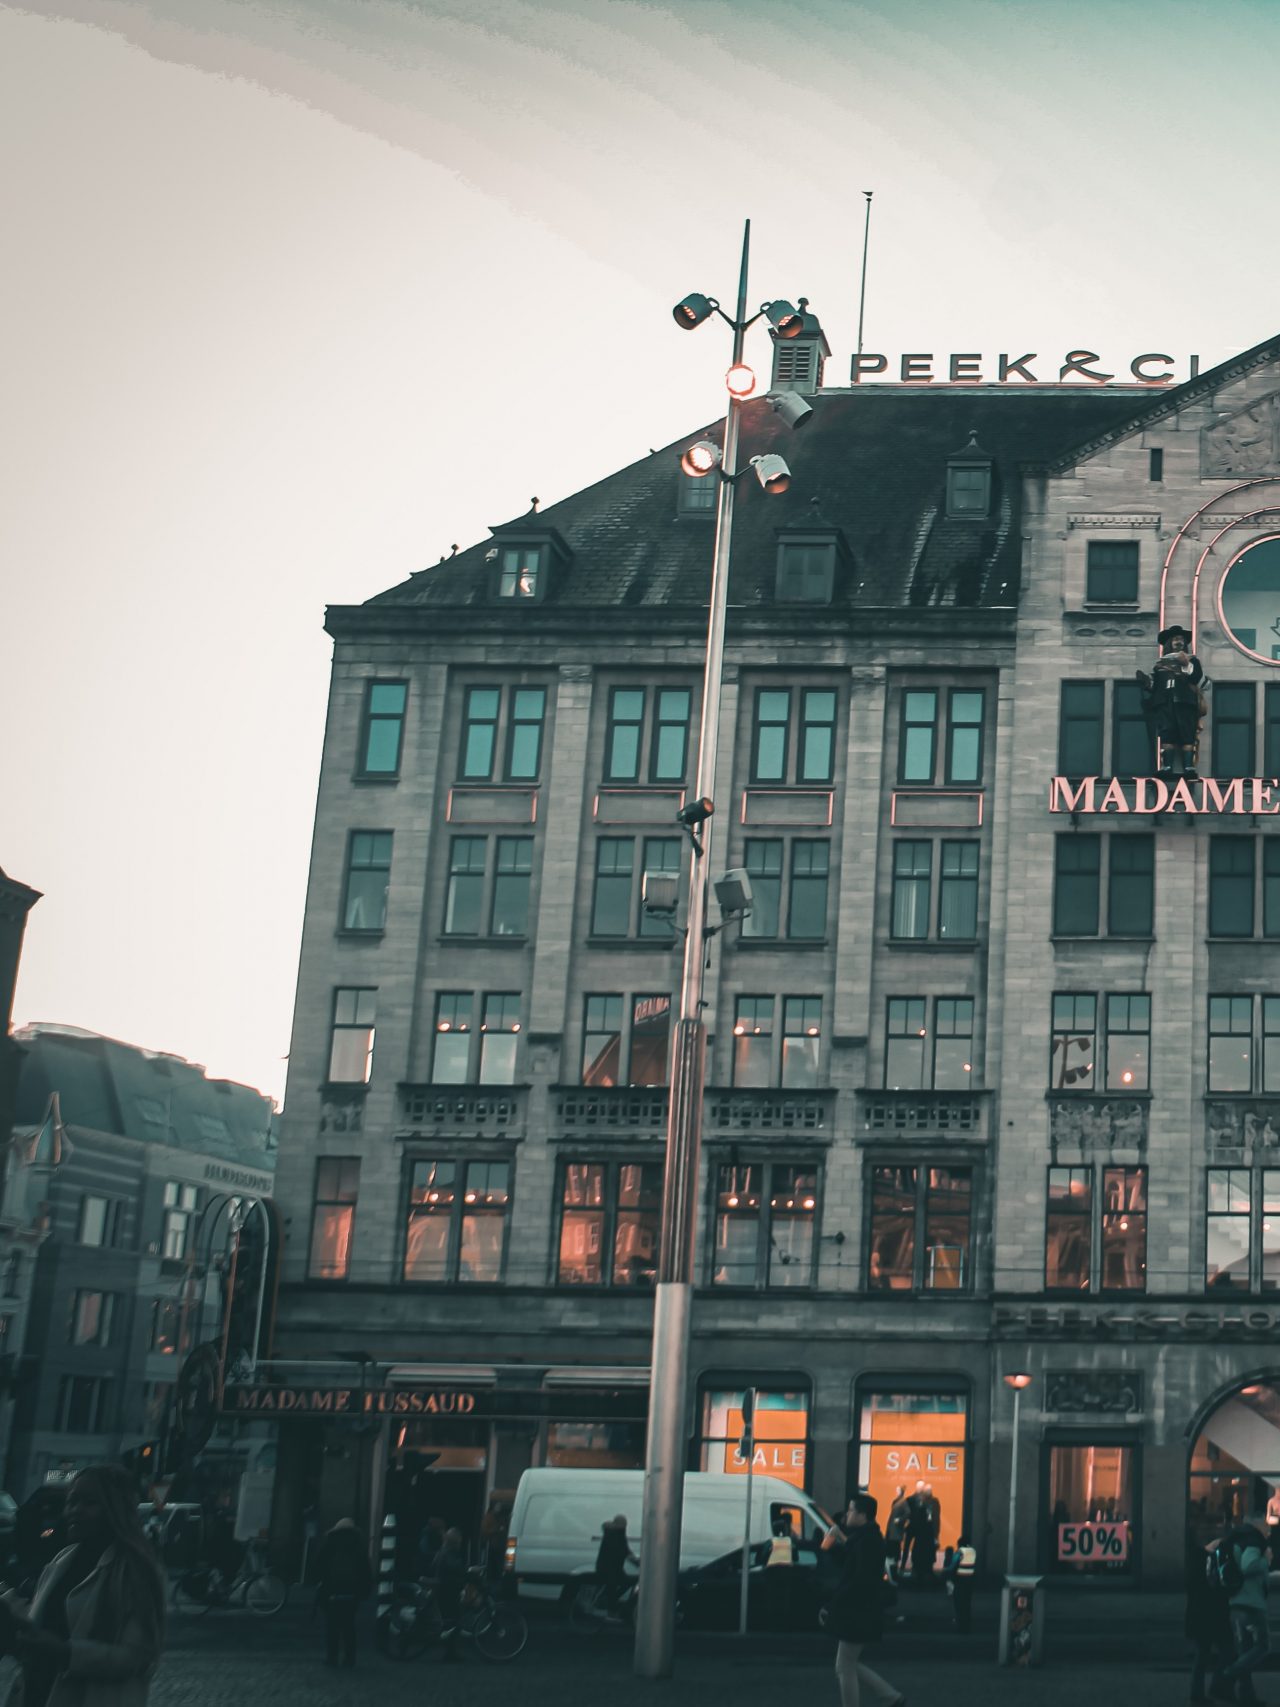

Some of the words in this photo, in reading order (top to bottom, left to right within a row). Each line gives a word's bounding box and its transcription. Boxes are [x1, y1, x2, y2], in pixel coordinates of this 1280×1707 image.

[849, 353, 1038, 384] PEEK
[1050, 776, 1280, 815] MADAME
[235, 1389, 351, 1412] MADAME
[731, 1447, 804, 1467] SALE
[884, 1451, 959, 1472] SALE
[1061, 1527, 1122, 1556] 50%
